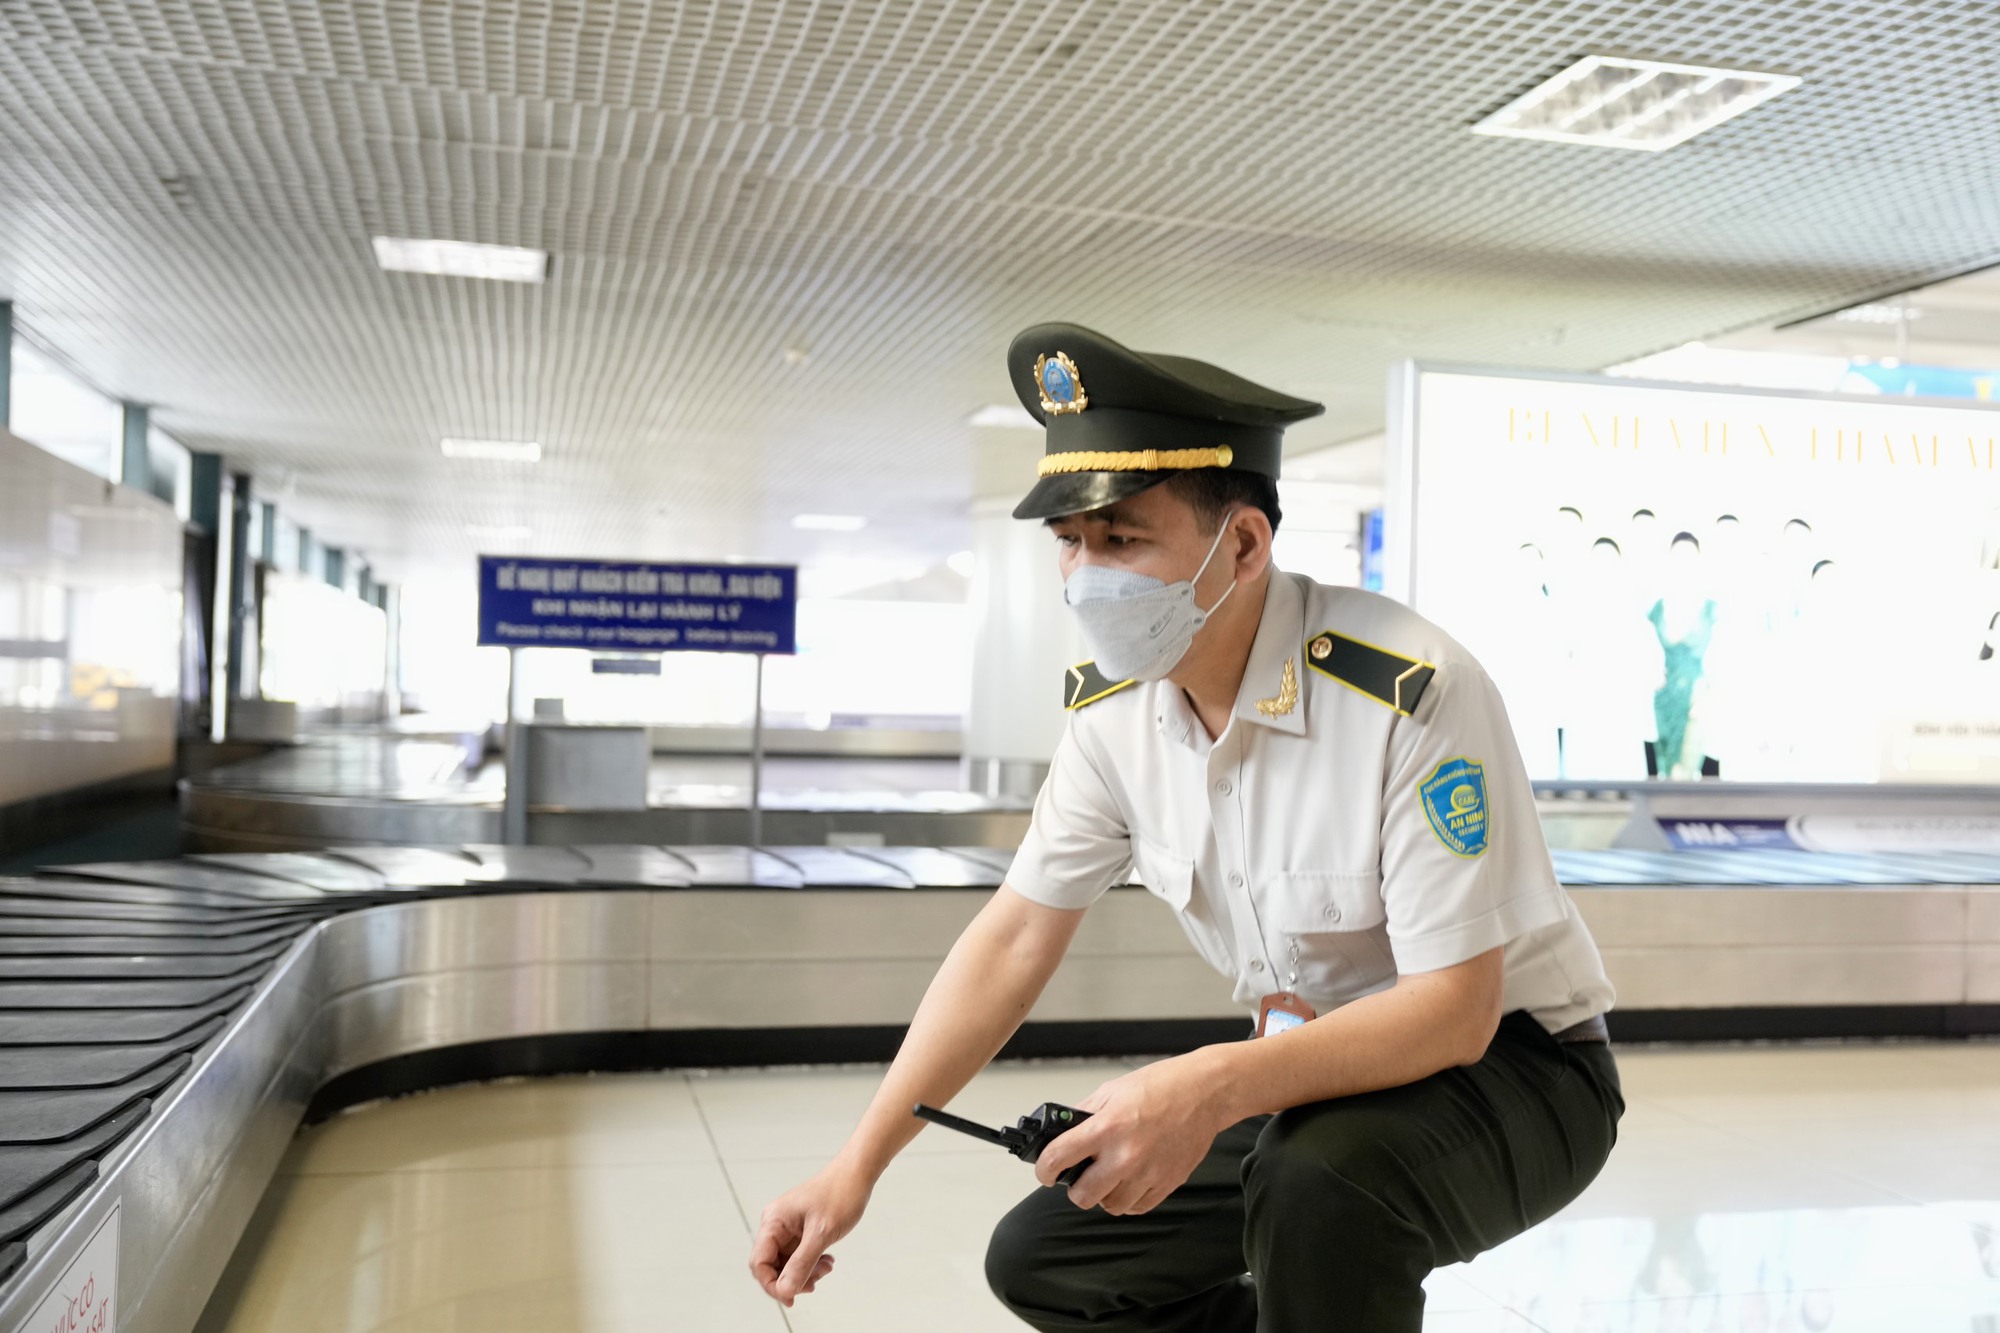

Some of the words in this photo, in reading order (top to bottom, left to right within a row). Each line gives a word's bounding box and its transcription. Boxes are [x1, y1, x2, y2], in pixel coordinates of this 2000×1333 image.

[532, 598, 566, 616] KHI
[568, 596, 624, 621] NHẬN
[626, 600, 659, 622] LẠI
[660, 599, 715, 621] HÀNH
[717, 600, 742, 622] LÝ
[496, 620, 540, 638] Please
[542, 622, 583, 640] check
[586, 626, 615, 642] your
[617, 625, 680, 644] baggage
[684, 626, 727, 643] before
[729, 628, 778, 648] leaving
[1451, 816, 1465, 831] AN
